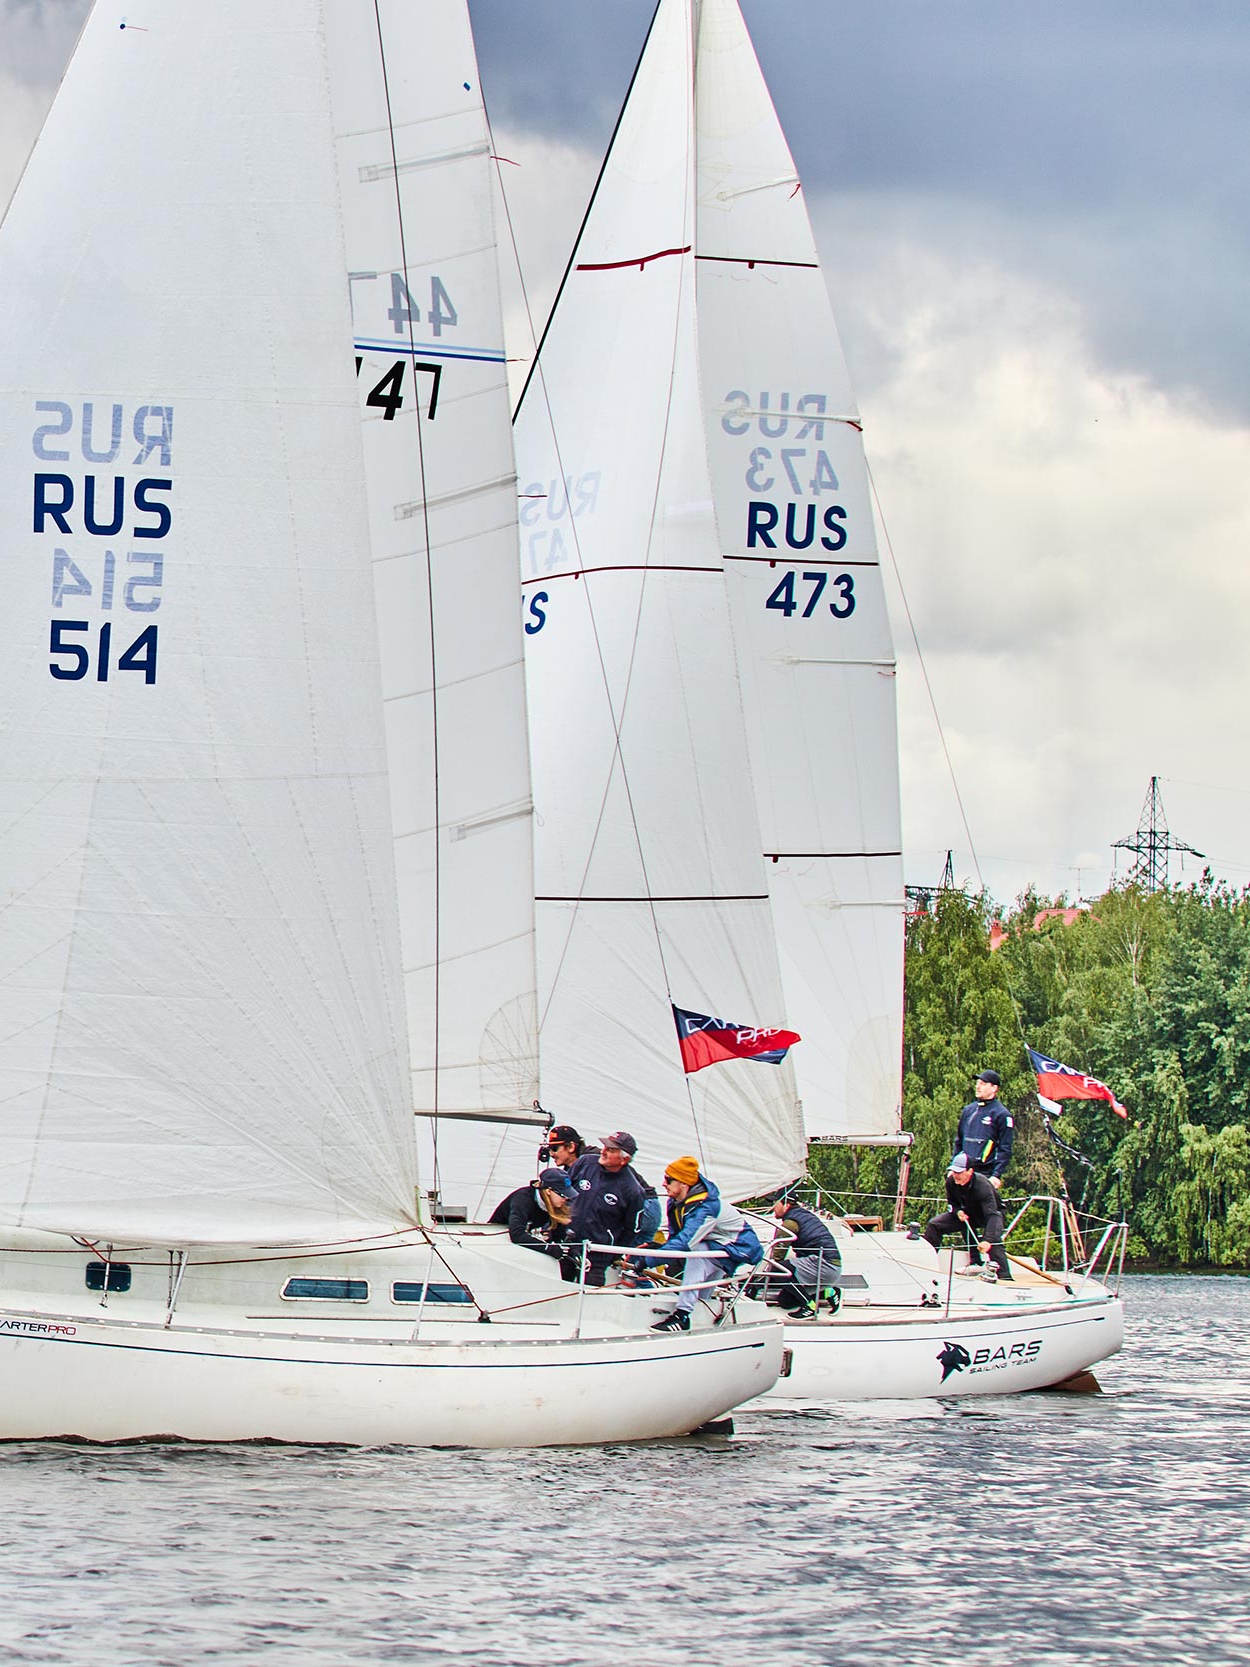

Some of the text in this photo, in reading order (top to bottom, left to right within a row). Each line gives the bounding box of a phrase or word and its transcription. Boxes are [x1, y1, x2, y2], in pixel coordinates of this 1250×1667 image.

[355, 357, 442, 420] 47
[33, 473, 172, 539] RUS
[747, 501, 847, 551] RUS
[765, 571, 856, 618] 473
[49, 620, 158, 684] 514
[969, 1357, 1037, 1374] SAILING TEAM
[972, 1340, 1043, 1365] BARS
